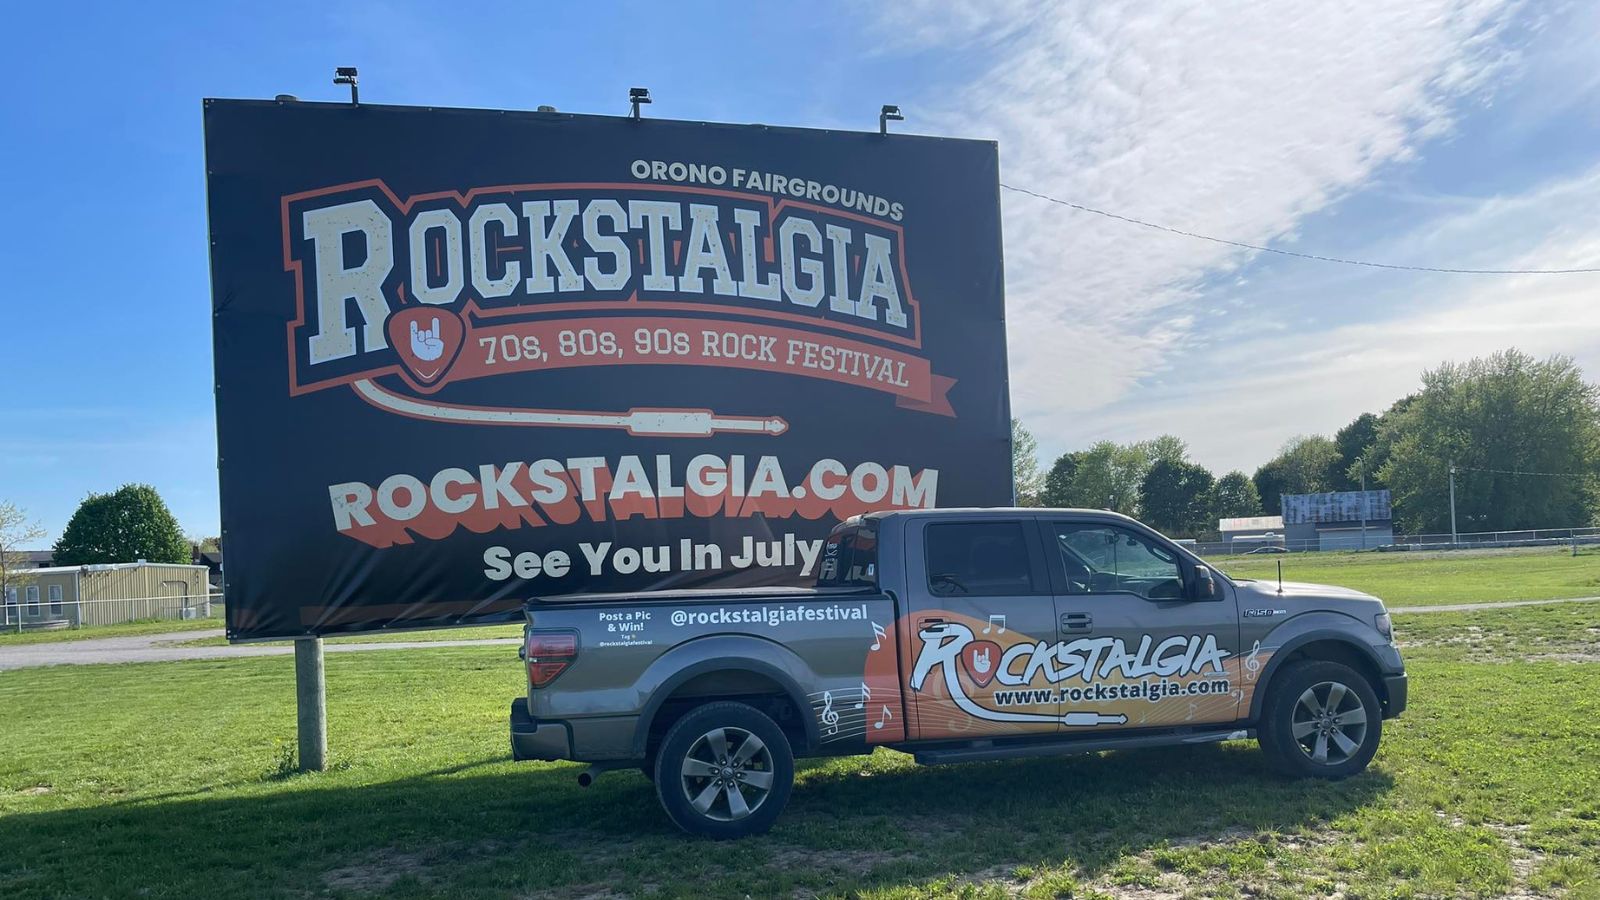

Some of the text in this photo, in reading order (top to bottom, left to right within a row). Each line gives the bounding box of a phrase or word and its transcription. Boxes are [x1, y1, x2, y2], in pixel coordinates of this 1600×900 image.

[631, 159, 905, 221] ORONO FAIRGROUNDS
[303, 198, 908, 365] ROCKSTALGIA
[479, 328, 910, 388] 70s, 80s, 90s ROCK FESTIVAL
[328, 453, 939, 532] ROCKSTALGIA.COM
[483, 533, 824, 581] See You In July
[599, 612, 623, 621] Post
[635, 611, 651, 620] Pic
[607, 622, 644, 632] & Win!
[670, 604, 868, 626] @rockstalgiafestival
[994, 679, 1230, 705] www.rockstalgia.com
